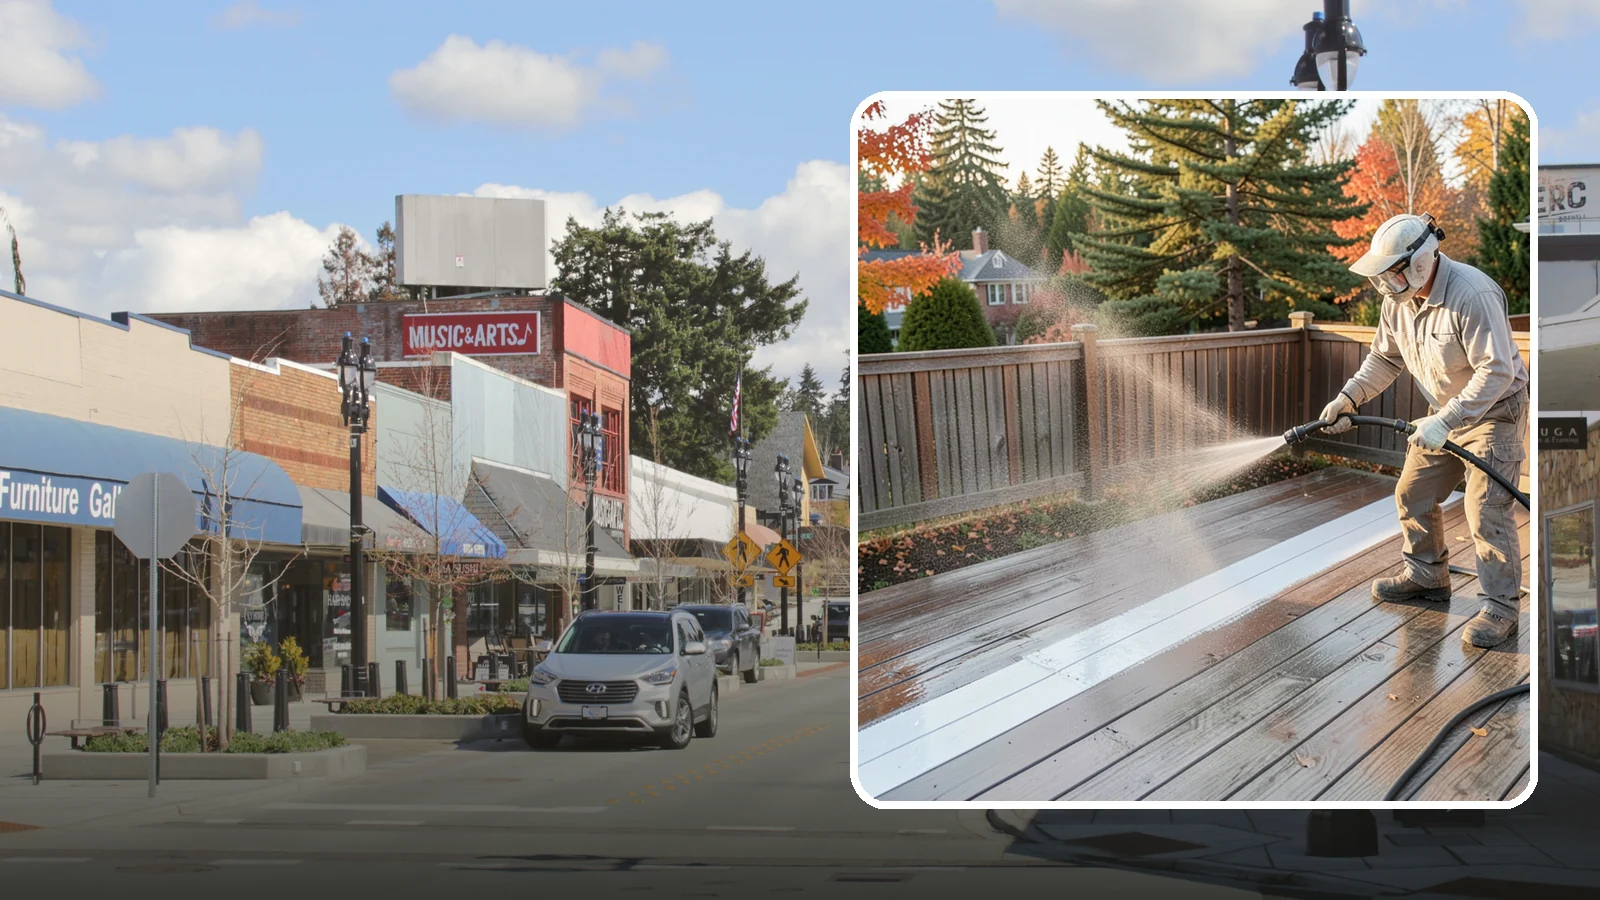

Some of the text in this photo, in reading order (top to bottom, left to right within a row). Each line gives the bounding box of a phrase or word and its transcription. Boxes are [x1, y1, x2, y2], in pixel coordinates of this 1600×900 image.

[0, 471, 122, 519] Furniture Gal
[453, 563, 479, 574] SUSHI
